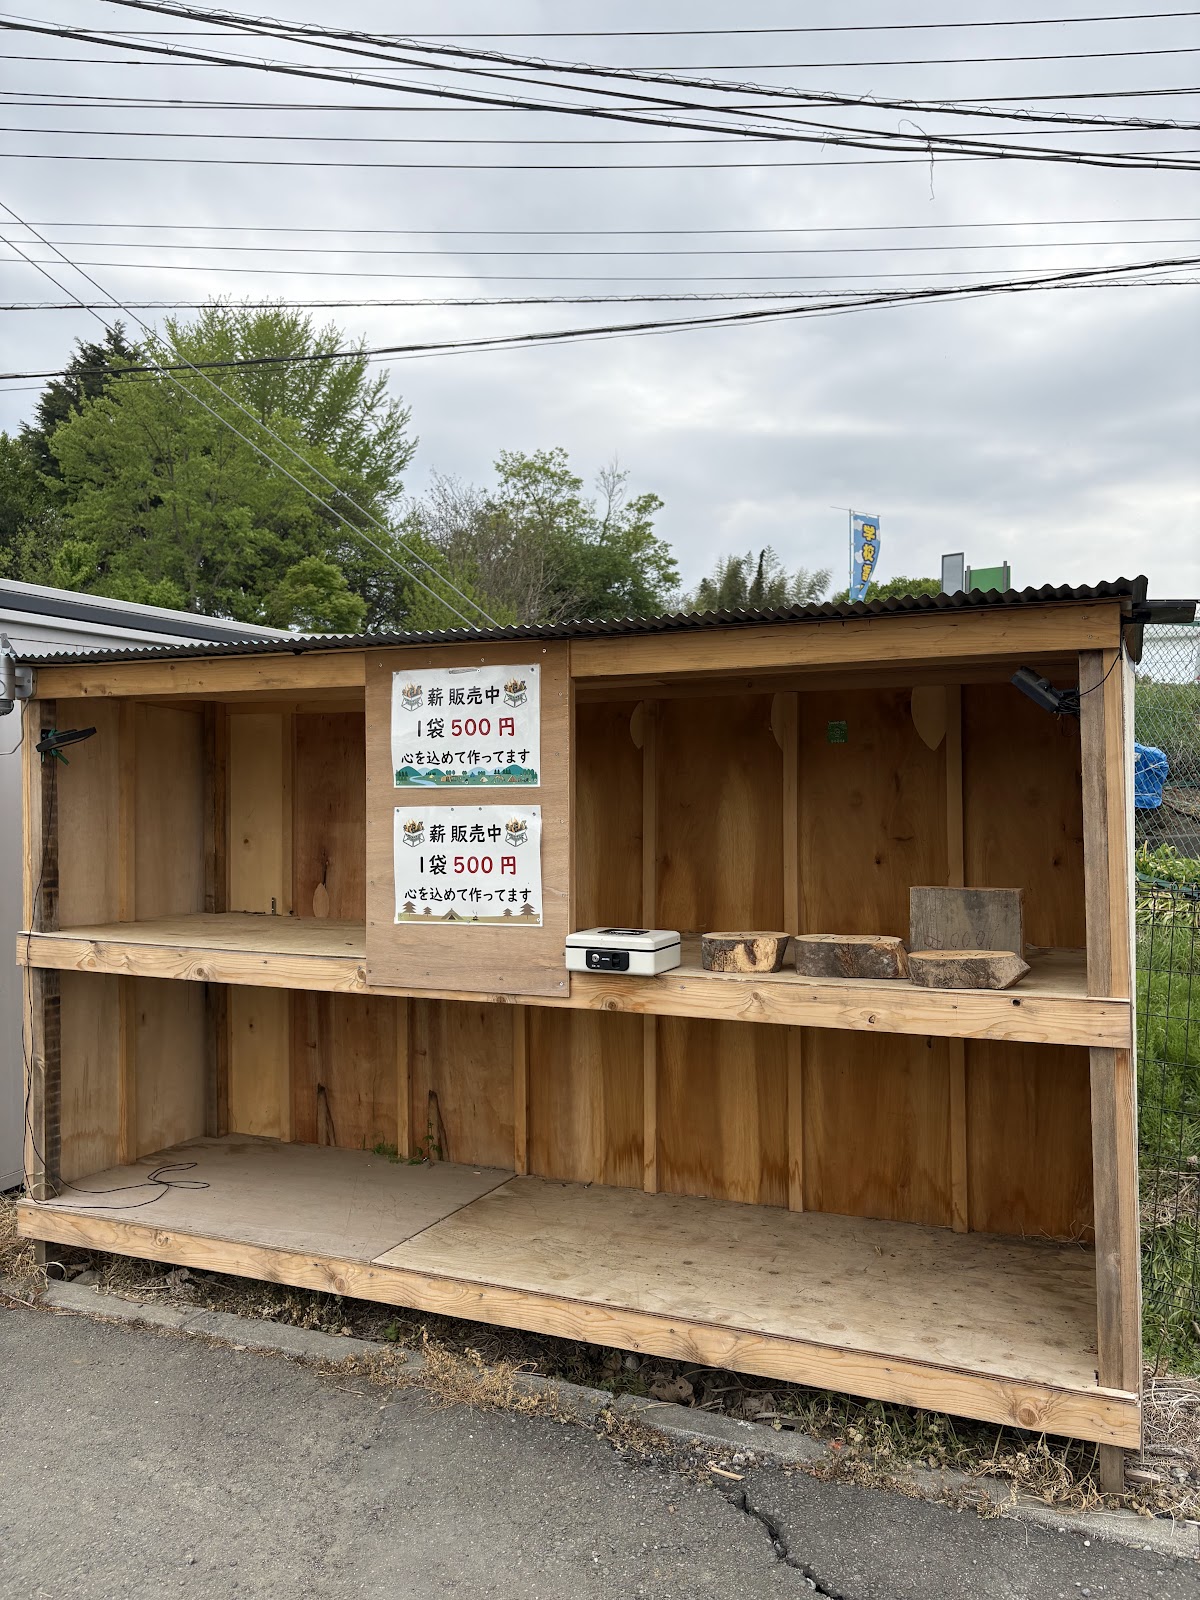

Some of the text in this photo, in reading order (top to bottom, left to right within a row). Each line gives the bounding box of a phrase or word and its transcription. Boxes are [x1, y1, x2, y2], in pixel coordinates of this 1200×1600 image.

[401, 749, 530, 766] 心を込めて作ってます
[404, 886, 532, 903] 心を込めて作ってます
